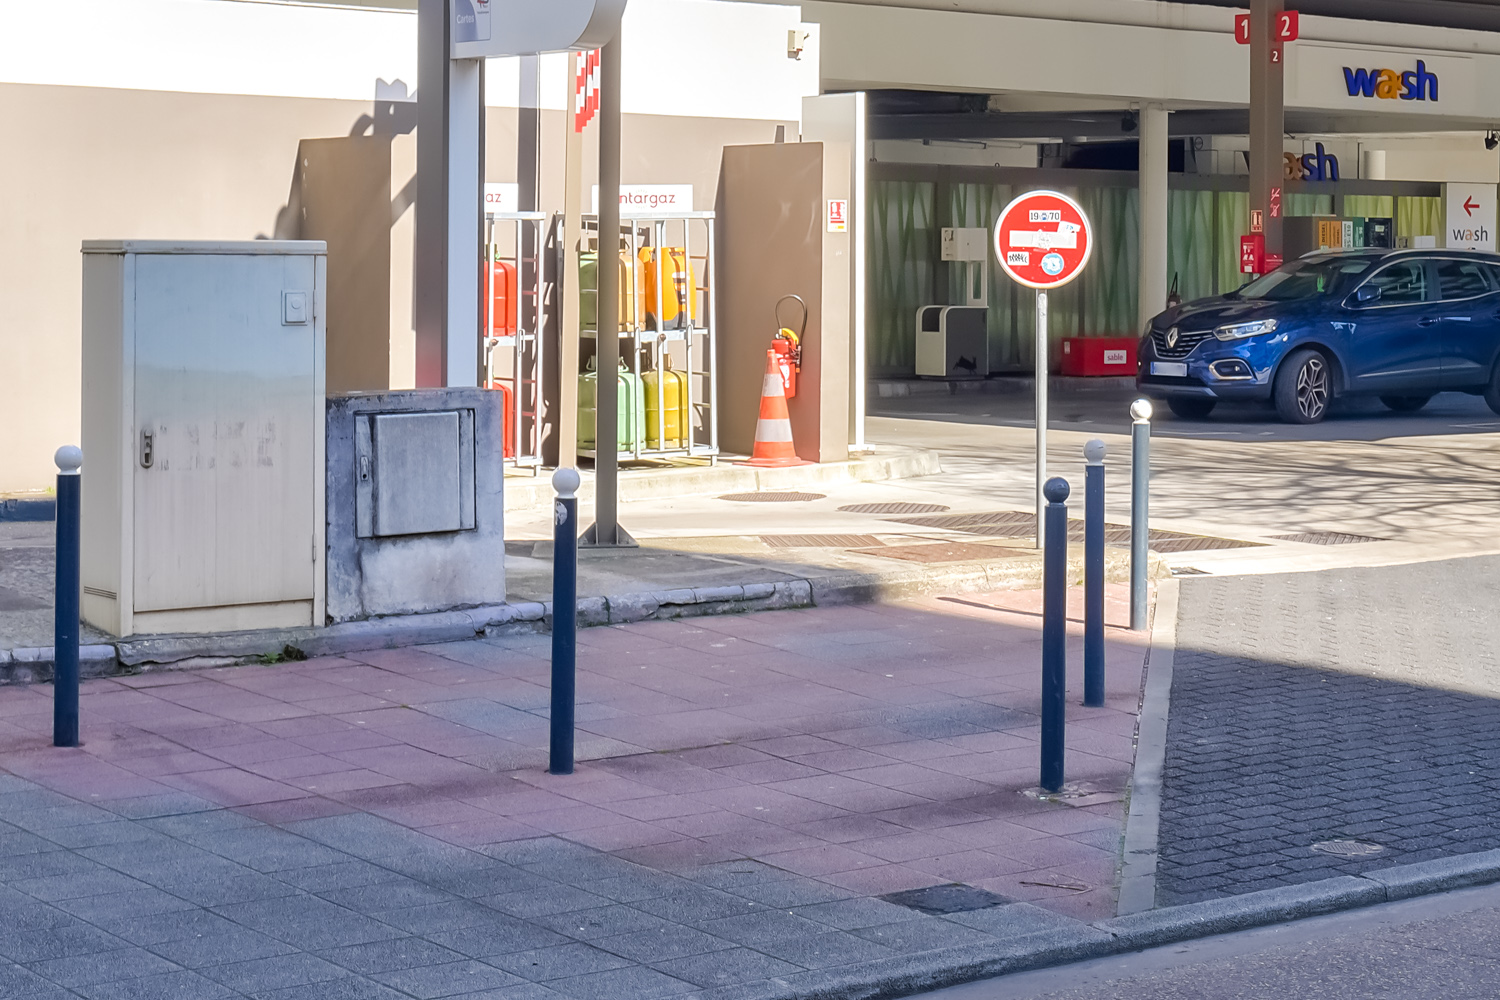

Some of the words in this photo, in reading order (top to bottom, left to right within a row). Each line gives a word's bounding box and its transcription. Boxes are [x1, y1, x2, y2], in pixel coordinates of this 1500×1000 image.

[456, 14, 475, 24] Cartes
[1280, 16, 1291, 37] 2
[1240, 19, 1249, 39] 1
[1272, 51, 1279, 62] 2
[1342, 60, 1438, 102] wash
[1242, 142, 1340, 182] ash
[619, 192, 676, 208] ntargaz
[1452, 225, 1488, 242] wash
[1107, 353, 1123, 361] sable
